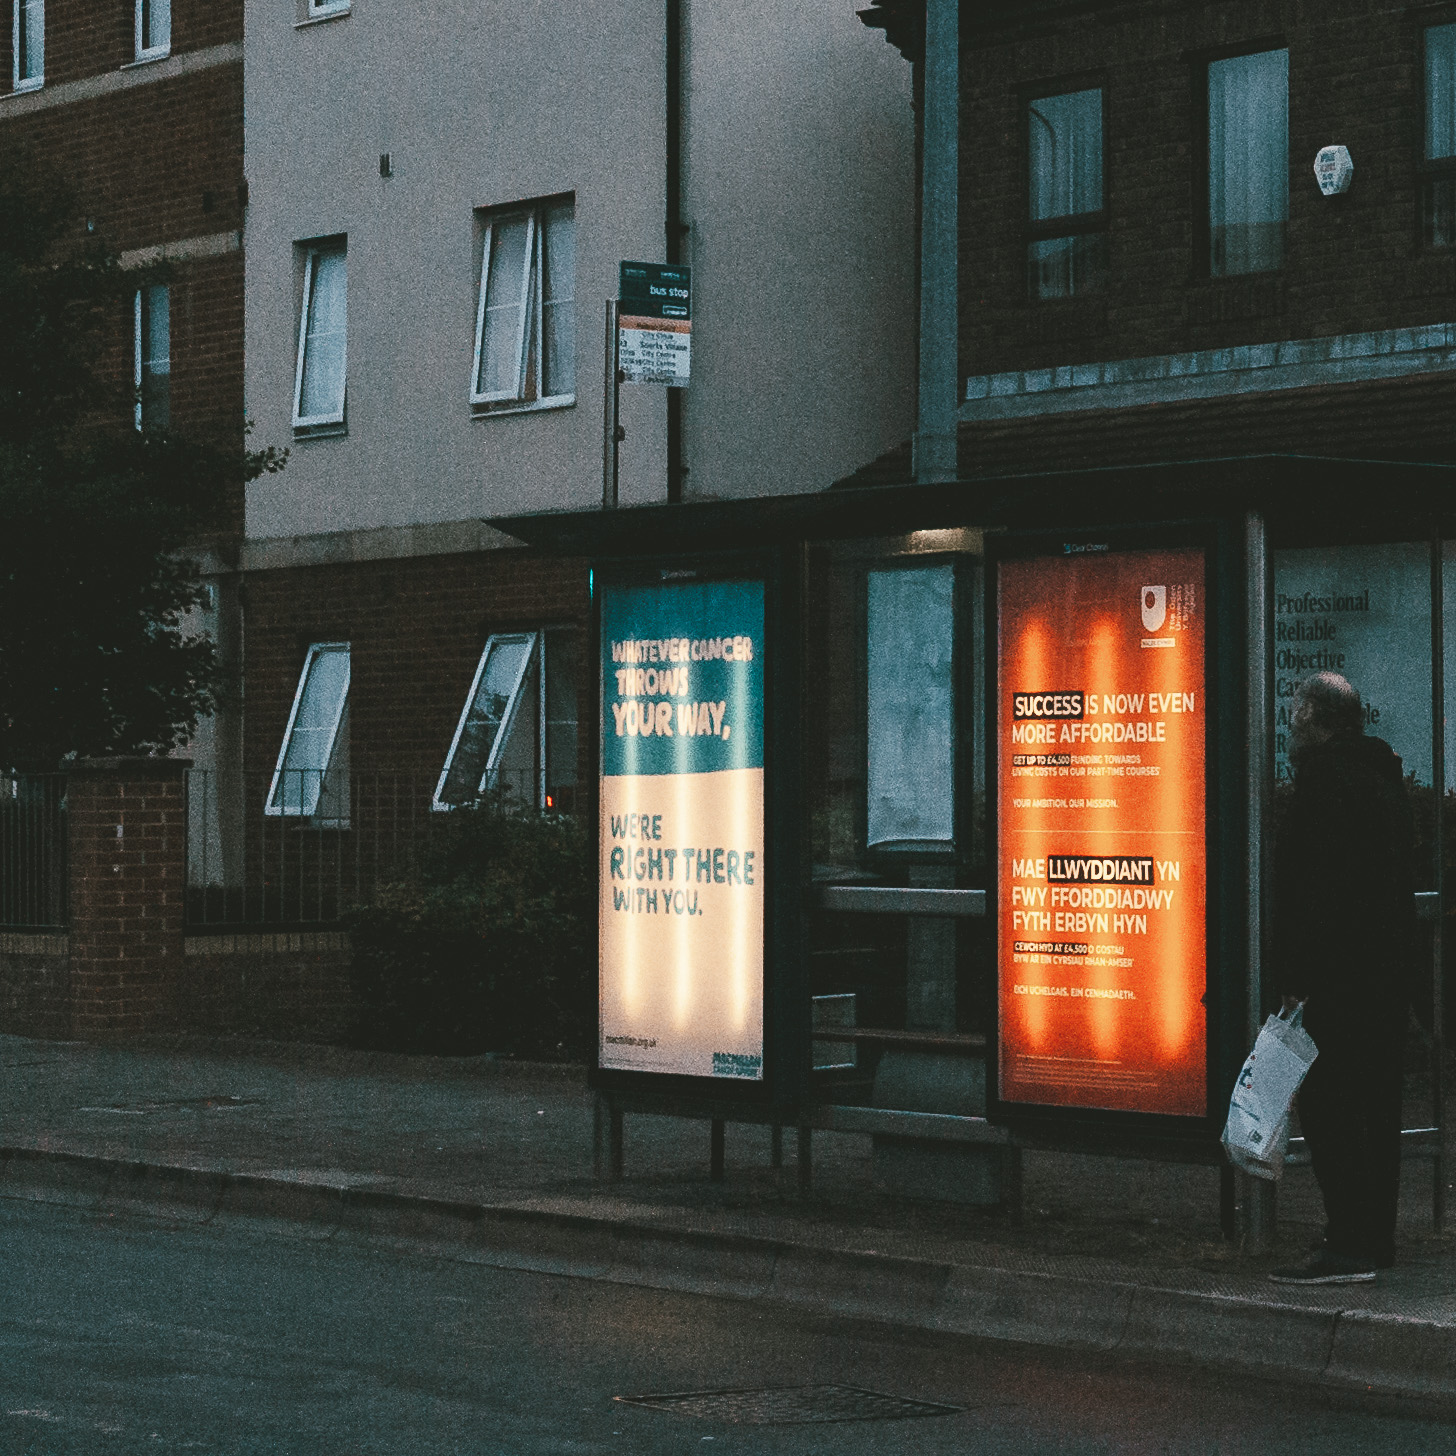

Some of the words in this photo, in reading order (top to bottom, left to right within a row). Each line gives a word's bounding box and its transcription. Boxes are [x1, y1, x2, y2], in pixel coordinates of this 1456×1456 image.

[649, 284, 667, 296] bus
[668, 287, 689, 299] stop
[1277, 590, 1369, 614] Professional
[1277, 619, 1336, 642] Reliable
[611, 638, 690, 663] WHATEVER
[691, 635, 753, 662] CANCER
[1276, 648, 1345, 674] Objective
[615, 667, 689, 696] THROWS
[1015, 695, 1082, 716] SUCCESS
[1085, 695, 1099, 715] IS
[1103, 694, 1144, 714] NOW
[1149, 692, 1195, 713] EVEN
[612, 700, 674, 737] YOUR
[677, 700, 731, 741] WAY,
[1012, 724, 1056, 744] MORE
[1059, 722, 1166, 743] AFFORDABLE
[1013, 755, 1026, 765] GET
[1027, 755, 1036, 765] UP
[1037, 755, 1046, 765] TO
[1071, 755, 1102, 765] FUNDING
[1104, 754, 1141, 764] TOWARDS
[1034, 767, 1057, 776] COSTS
[1059, 767, 1068, 776] ON
[1070, 767, 1085, 776] OUR
[1087, 767, 1124, 776] PART-TIME
[1013, 799, 1031, 808] YOUR
[1069, 799, 1084, 808] OUR
[611, 813, 662, 841] WE'RE
[610, 845, 677, 881] RIGHT
[682, 848, 755, 886] THERE
[1012, 859, 1045, 878] MAE
[1049, 859, 1152, 881] LLWYDDIANT
[1156, 861, 1180, 881] YN
[613, 886, 658, 914] WITH
[662, 888, 703, 916] YOU.
[1012, 887, 1047, 907] FWY
[1051, 887, 1174, 910] FFORDDIADWY
[1013, 911, 1051, 931] FYTH
[1055, 912, 1109, 933] ERBYN
[1113, 914, 1147, 935] HYN
[1054, 943, 1063, 953] AT
